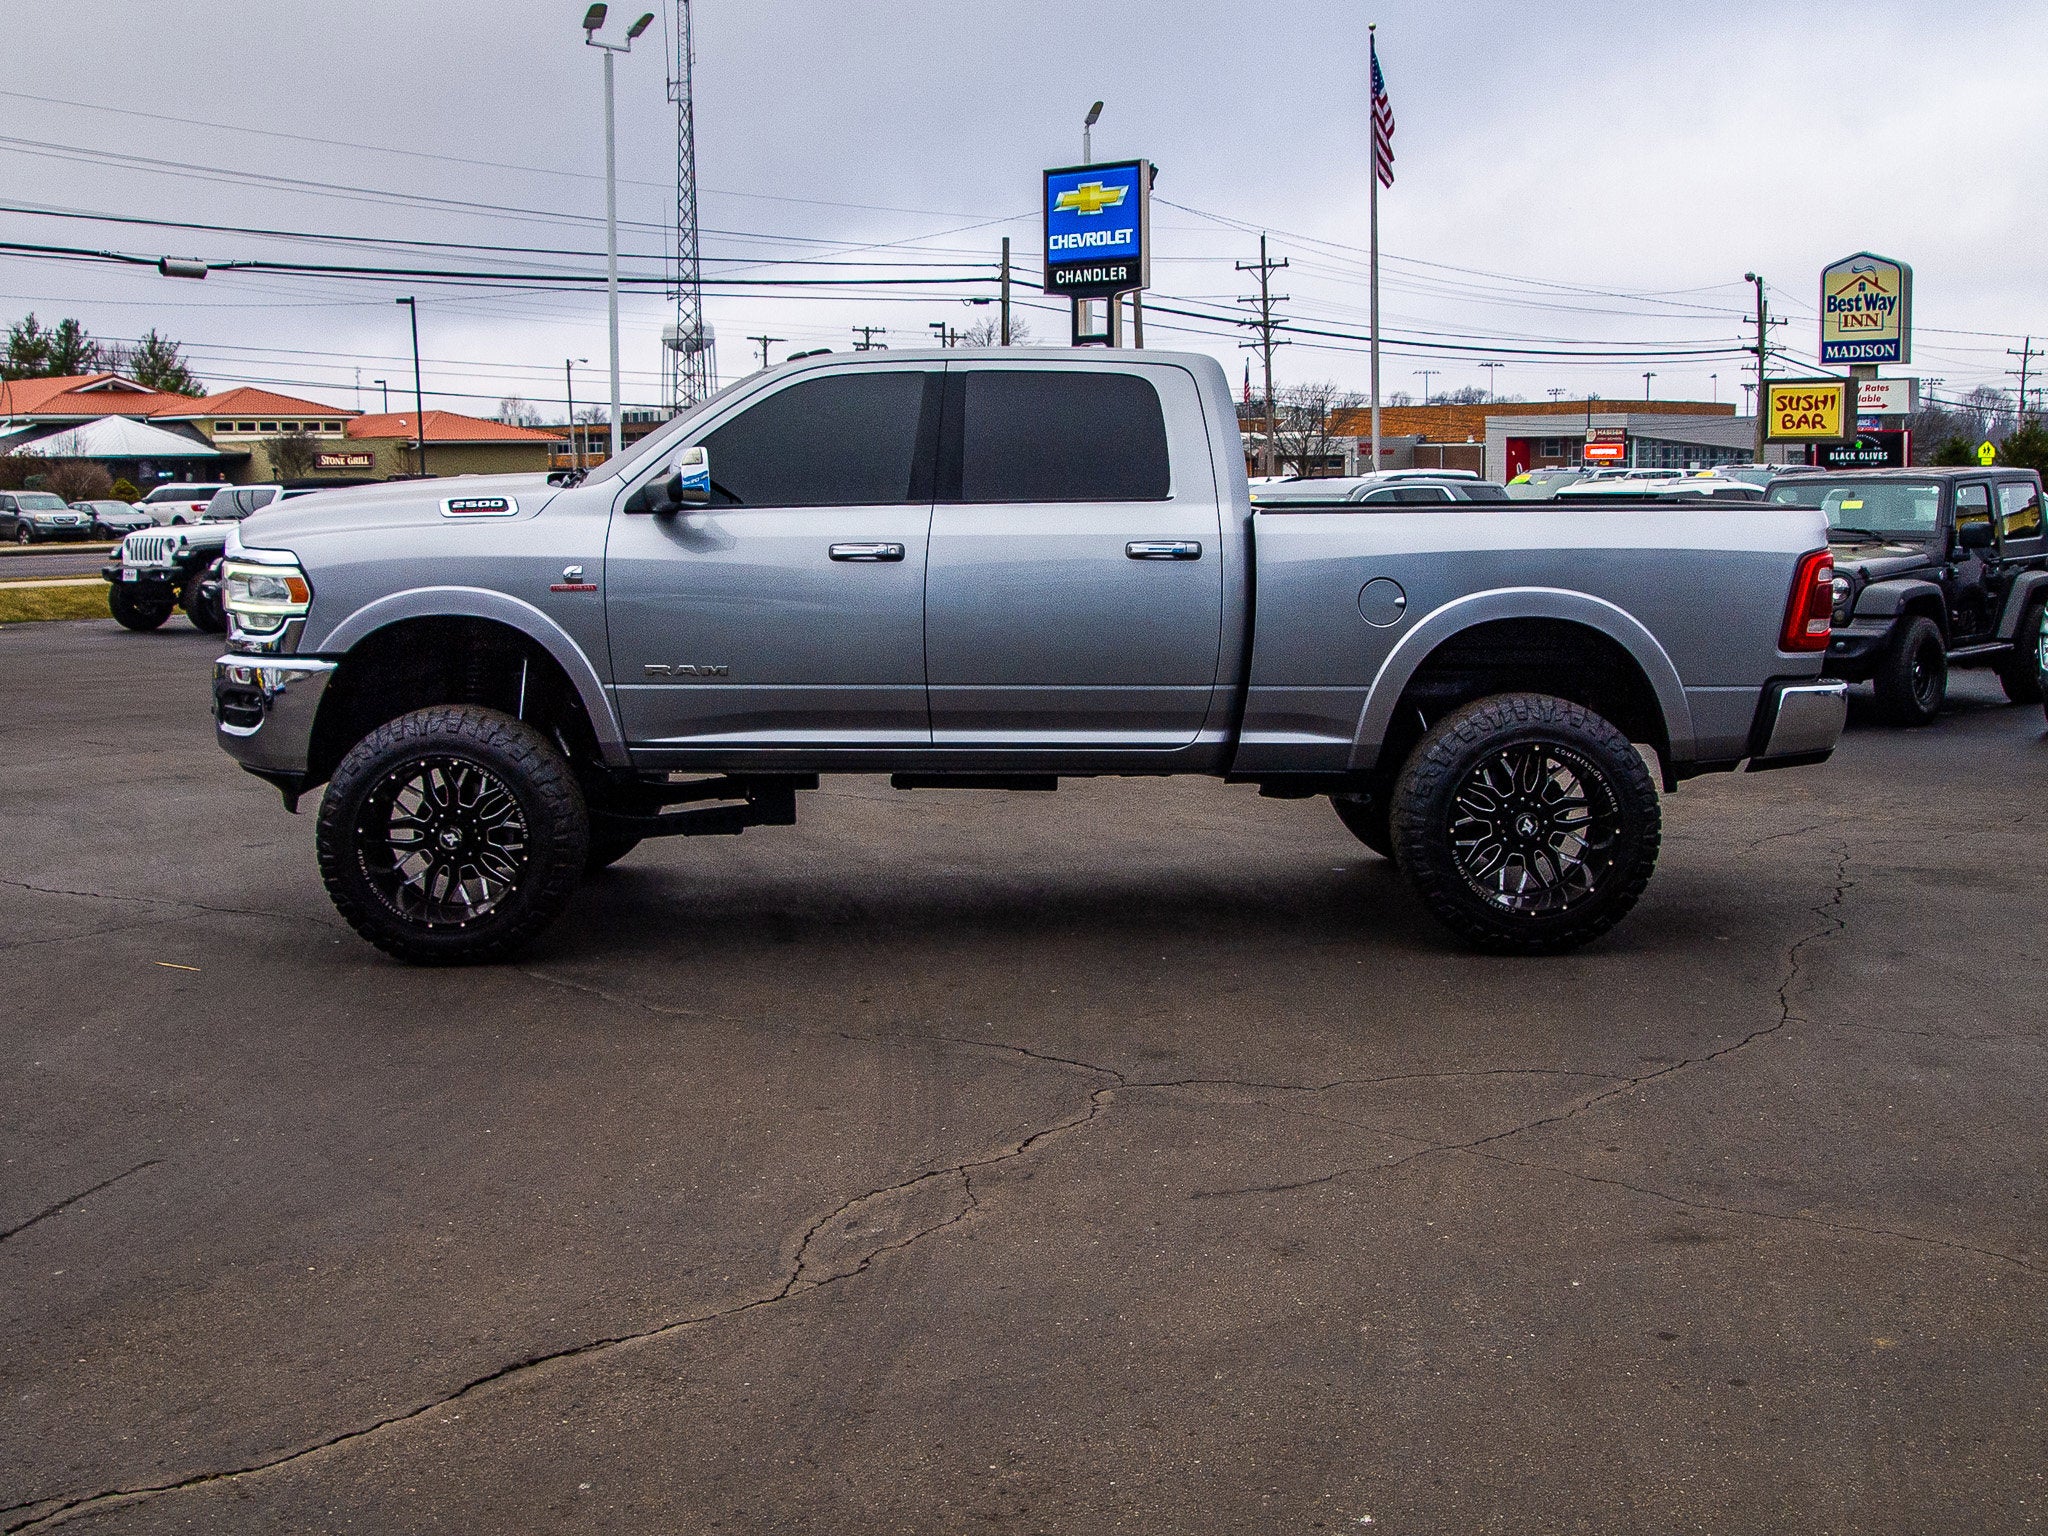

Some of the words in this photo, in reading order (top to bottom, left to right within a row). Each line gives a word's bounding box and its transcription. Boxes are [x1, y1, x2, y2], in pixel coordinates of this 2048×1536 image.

[1049, 228, 1134, 250] CHEVROLET
[1056, 266, 1127, 284] CHANDLER
[1826, 294, 1862, 313] Best
[1863, 292, 1897, 316] Way
[1843, 313, 1880, 328] INN
[1826, 344, 1896, 359] MADISON
[1865, 384, 1890, 392] Rates
[1775, 394, 1837, 412] SUSHI
[1858, 394, 1882, 403] lable
[1781, 413, 1828, 430] BAR
[320, 455, 345, 466] STONE
[347, 455, 370, 465] GRILL
[1829, 451, 1856, 460] BLACK
[1859, 451, 1888, 460] OLIVES
[452, 500, 504, 509] 2500
[643, 664, 729, 677] RAM
